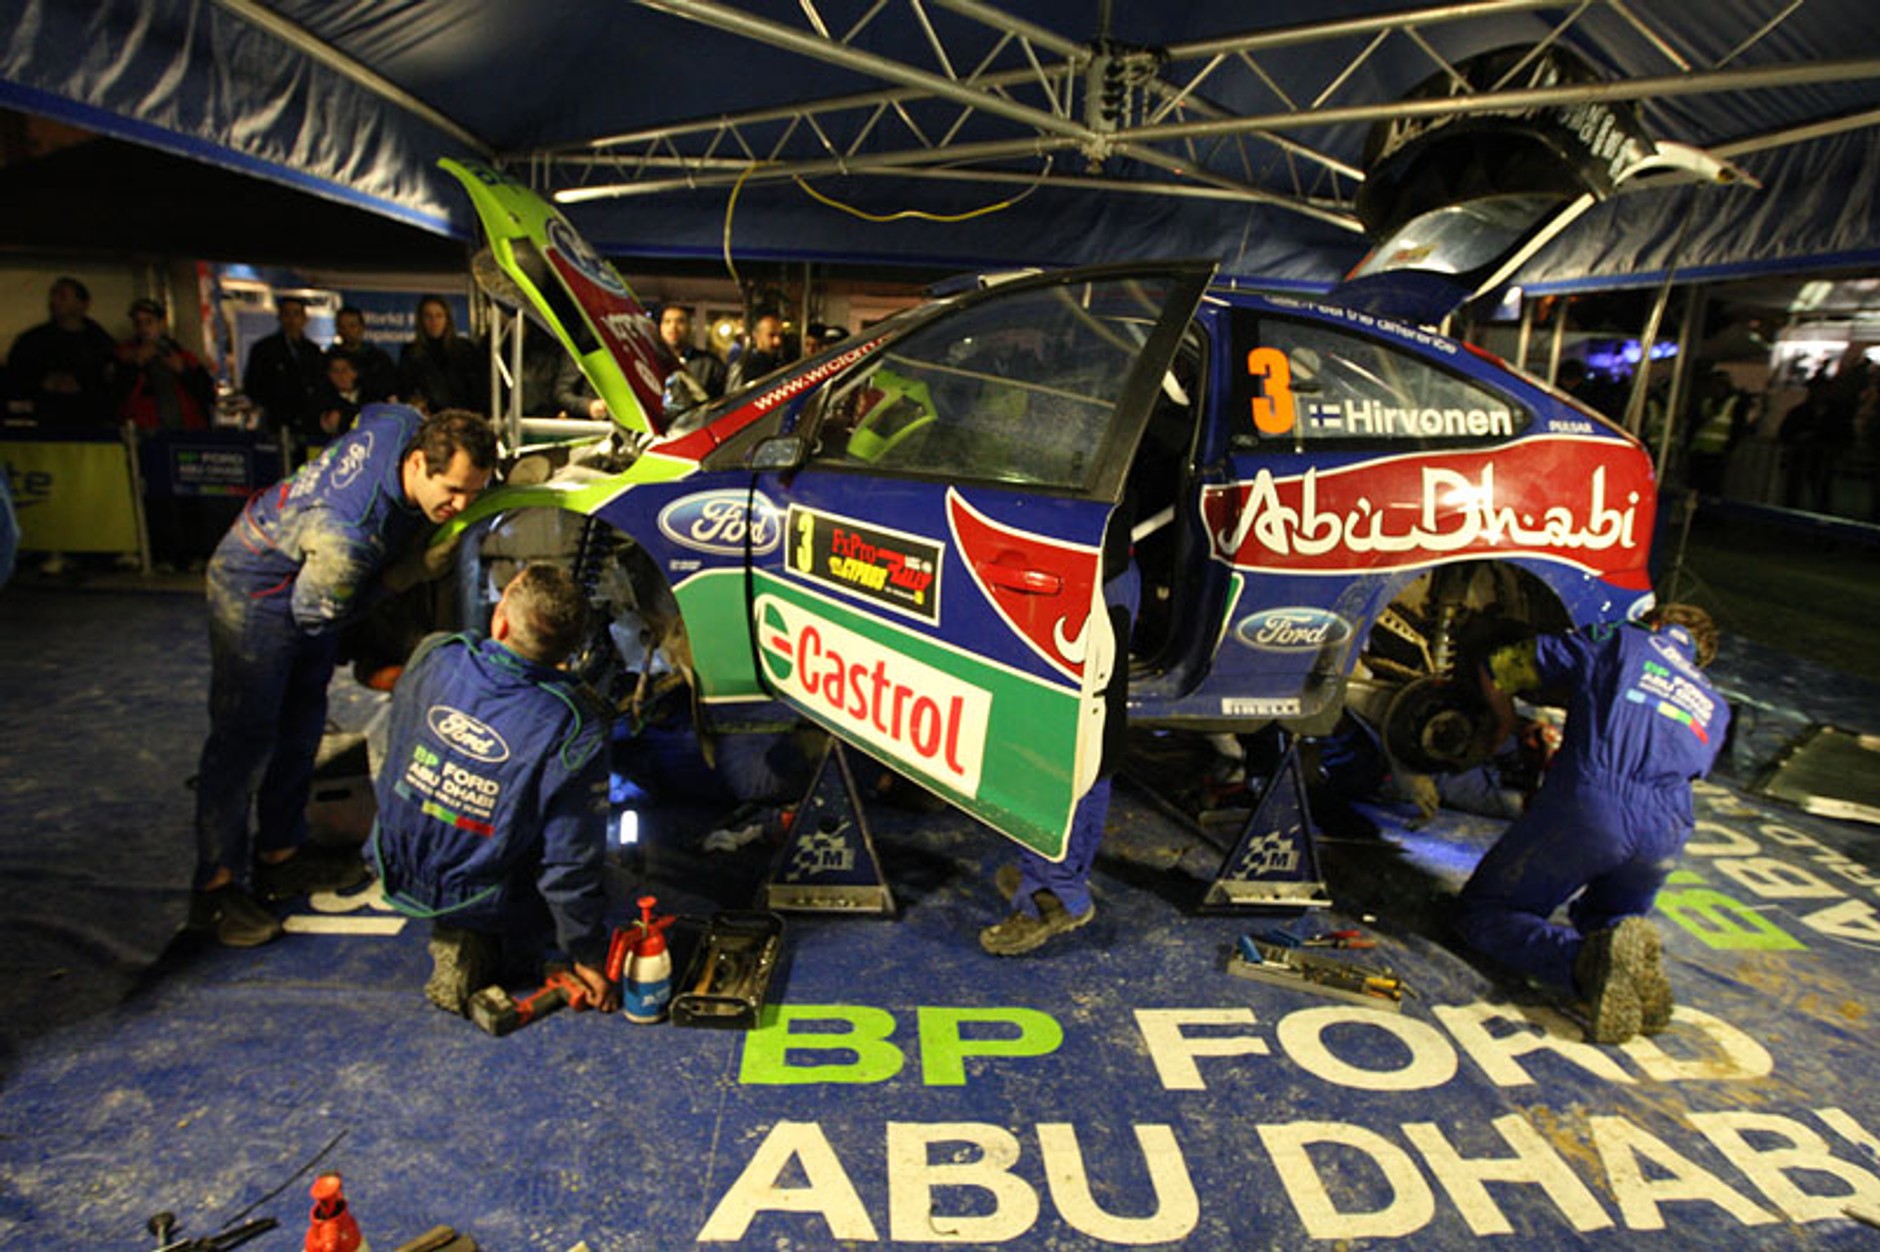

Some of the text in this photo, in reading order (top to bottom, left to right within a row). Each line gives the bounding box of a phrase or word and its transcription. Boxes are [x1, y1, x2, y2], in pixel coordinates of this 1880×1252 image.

[1248, 347, 1514, 437] 3 Hirvonen
[690, 500, 766, 545] Ford
[797, 512, 814, 573] 3
[1257, 614, 1328, 645] Ford
[796, 624, 966, 776] Castrol
[439, 713, 495, 755] Ford
[442, 761, 500, 796] FORD
[738, 1000, 1774, 1092] BP FORD
[695, 1118, 1200, 1245] ABU
